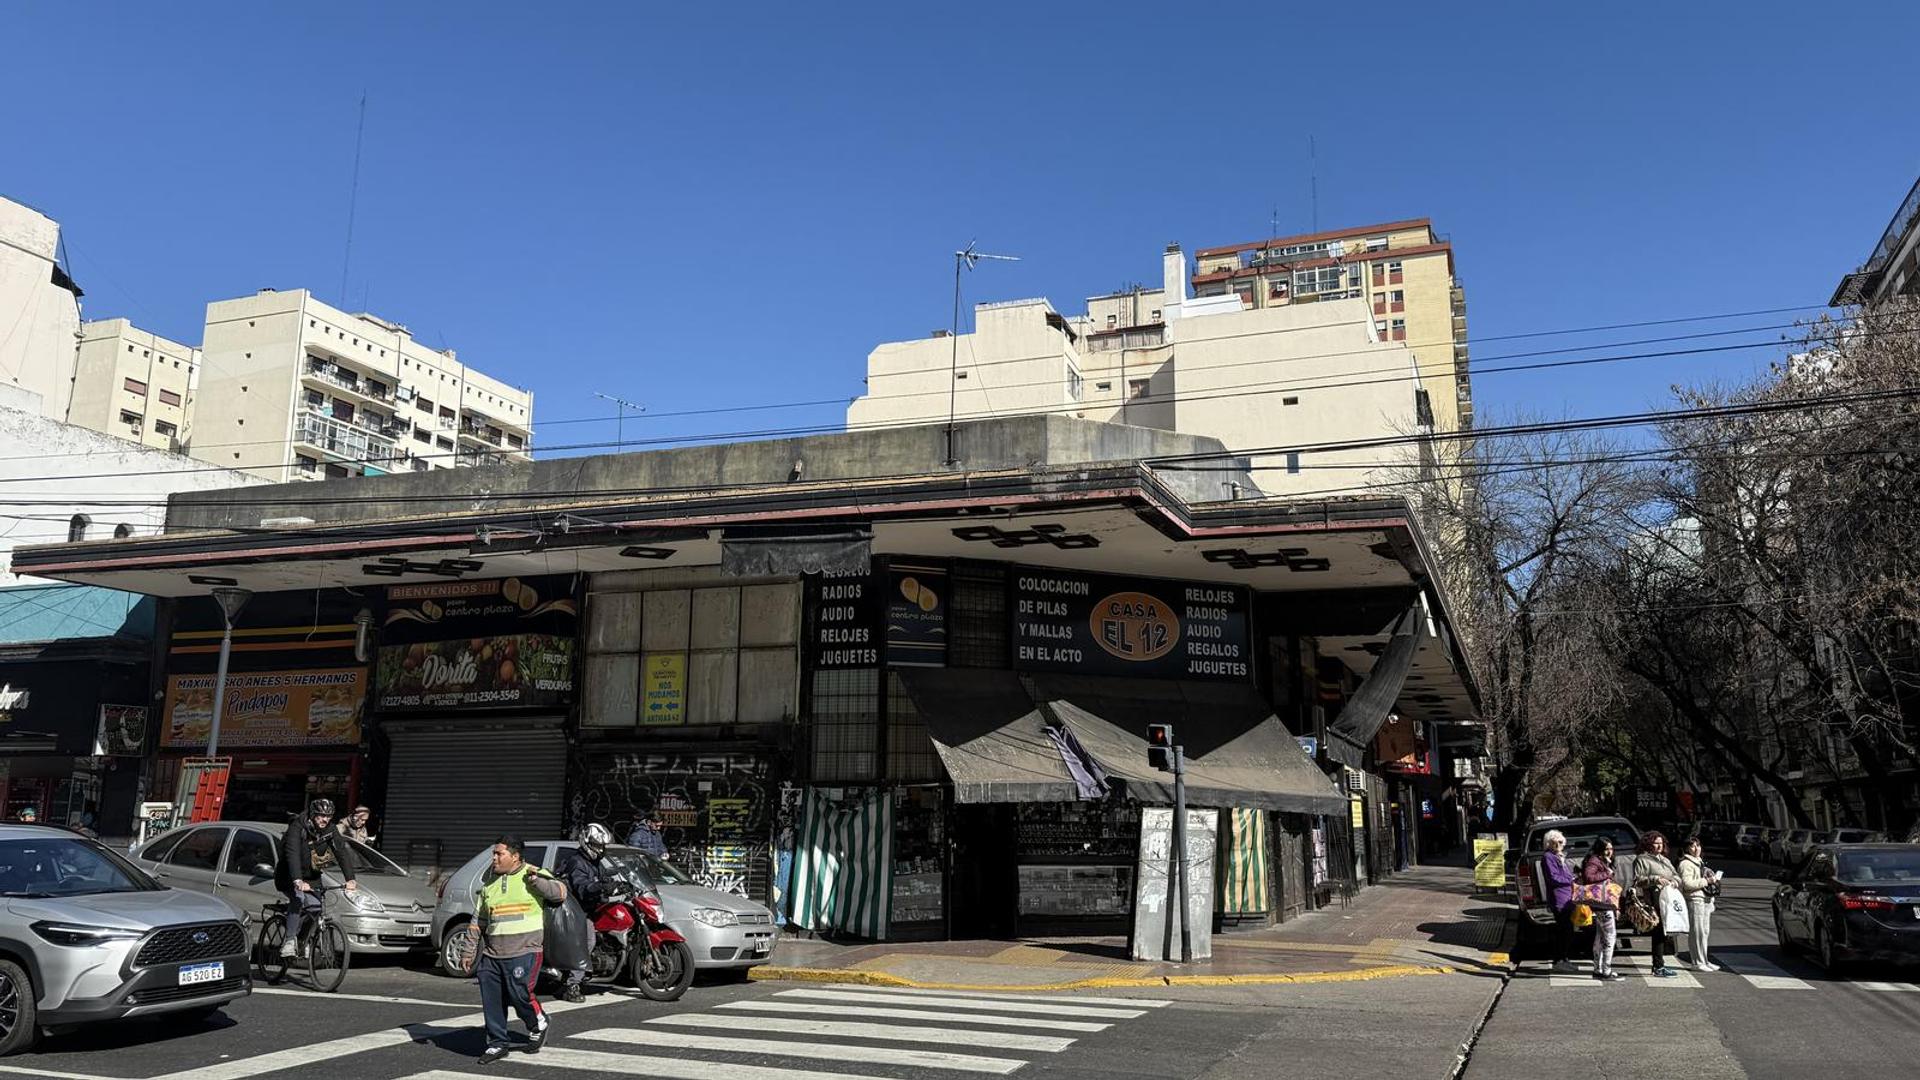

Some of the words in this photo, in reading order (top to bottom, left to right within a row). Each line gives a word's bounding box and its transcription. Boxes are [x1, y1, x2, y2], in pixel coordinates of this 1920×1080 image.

[393, 585, 478, 598] BIENVENIDOS
[822, 584, 862, 600] RADIOS
[1019, 577, 1089, 596] COLOCACION
[1185, 588, 1234, 604] RELOJES
[821, 606, 855, 621] AUDIO
[1019, 600, 1034, 614] DE
[1037, 601, 1067, 616] PILAS
[1111, 602, 1157, 618] CASA
[1186, 606, 1228, 621] RADIOS
[821, 628, 869, 643] RELOJES
[1019, 623, 1027, 636] Y
[1030, 624, 1073, 640] MALLAS
[1103, 620, 1133, 653] EL
[1140, 622, 1169, 655] 12
[1187, 625, 1221, 638] AUDIO
[820, 648, 877, 665] JUGUETES
[1019, 646, 1034, 660] EN
[1039, 647, 1050, 660] EL
[1054, 648, 1082, 662] ACTO
[1188, 642, 1239, 657] REGALOS
[543, 653, 570, 664] FRUTAS
[422, 651, 478, 689] Dorita
[1188, 660, 1247, 676] JUGUETES
[177, 677, 243, 689] MAXIKISKO
[534, 679, 572, 691] VERDURAS
[659, 681, 672, 689] NOS
[648, 690, 680, 698] MUDAMOS
[226, 690, 288, 716] Pindapoy
[182, 972, 192, 982] AG
[194, 970, 209, 981] 520
[212, 968, 222, 978] EZ
